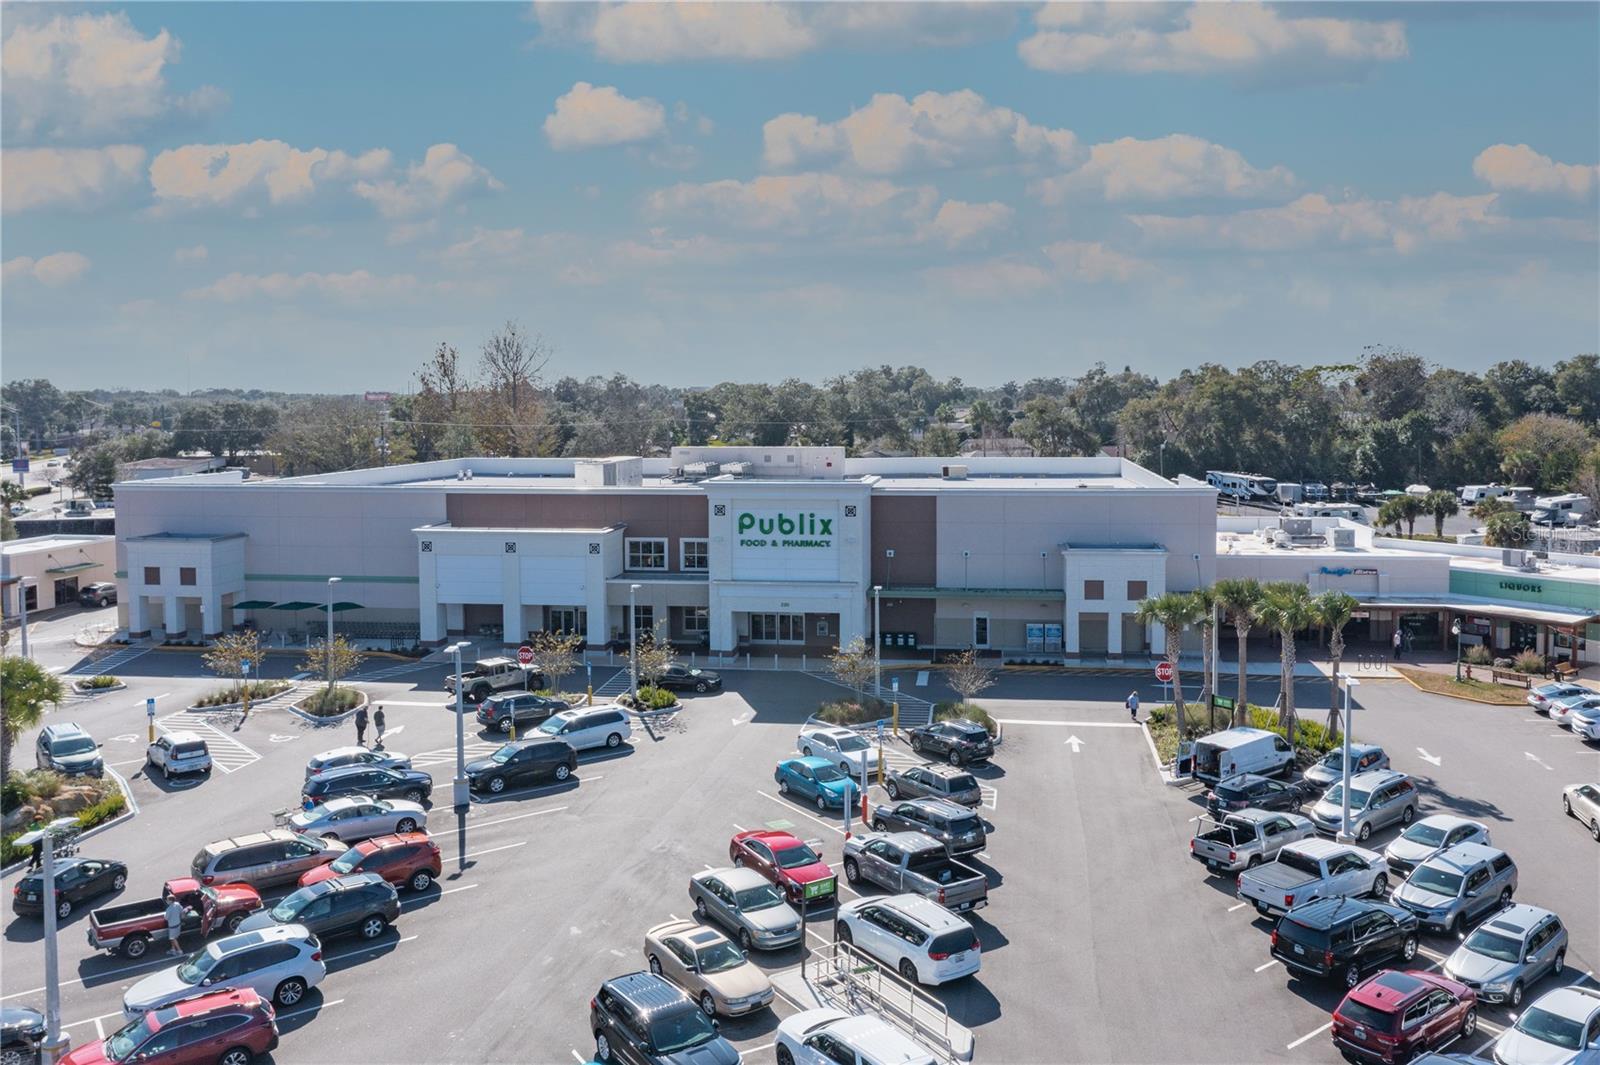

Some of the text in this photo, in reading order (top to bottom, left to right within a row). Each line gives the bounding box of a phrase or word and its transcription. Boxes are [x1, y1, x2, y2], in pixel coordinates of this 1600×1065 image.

[738, 512, 833, 535] Publix
[740, 539, 767, 547] FOOD
[782, 540, 832, 548] PHARMACY
[1499, 582, 1542, 593] LIQUORS
